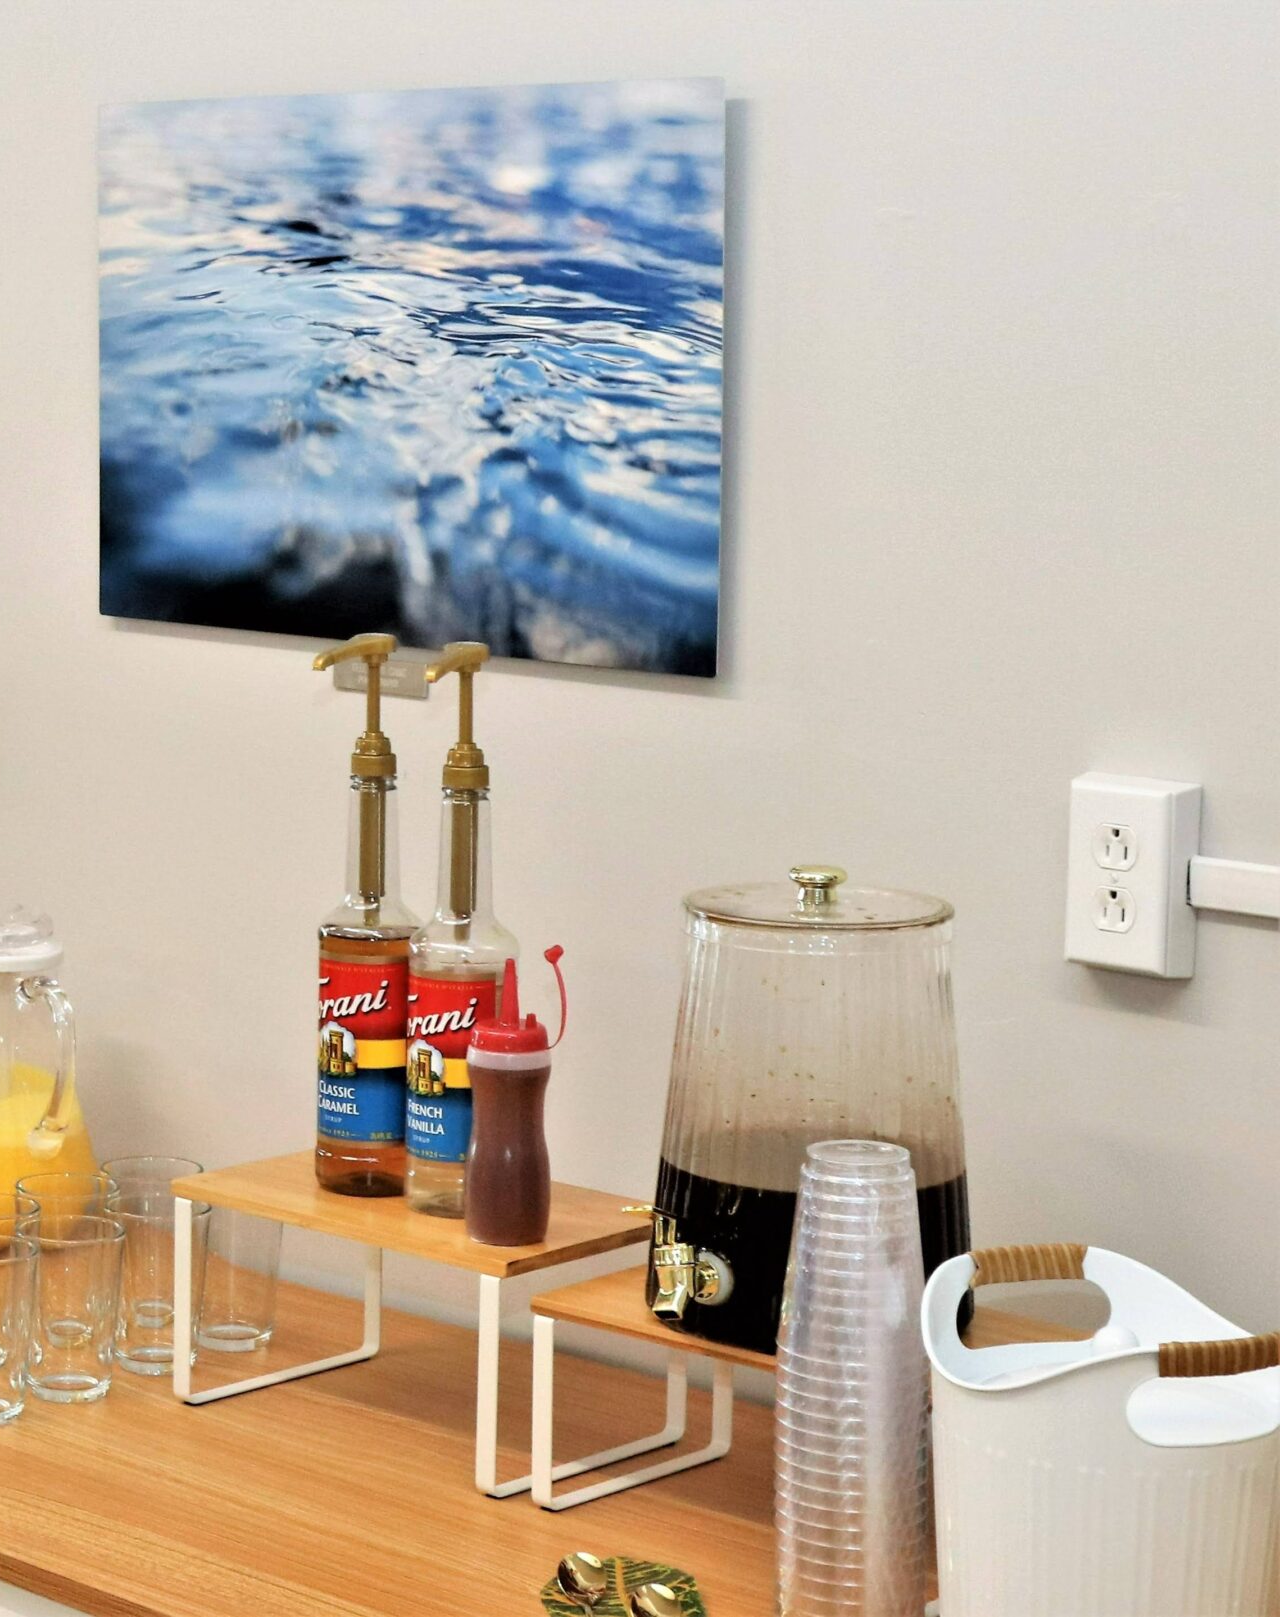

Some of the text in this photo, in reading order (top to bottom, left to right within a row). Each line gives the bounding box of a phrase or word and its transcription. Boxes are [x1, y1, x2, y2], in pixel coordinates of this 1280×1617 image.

[318, 976, 389, 1019] rani
[407, 994, 478, 1038] rani
[319, 1080, 356, 1099] CLASSIC
[318, 1094, 360, 1116] CARAMEL
[407, 1098, 443, 1119] FRENCH
[407, 1113, 445, 1135] VANILLA
